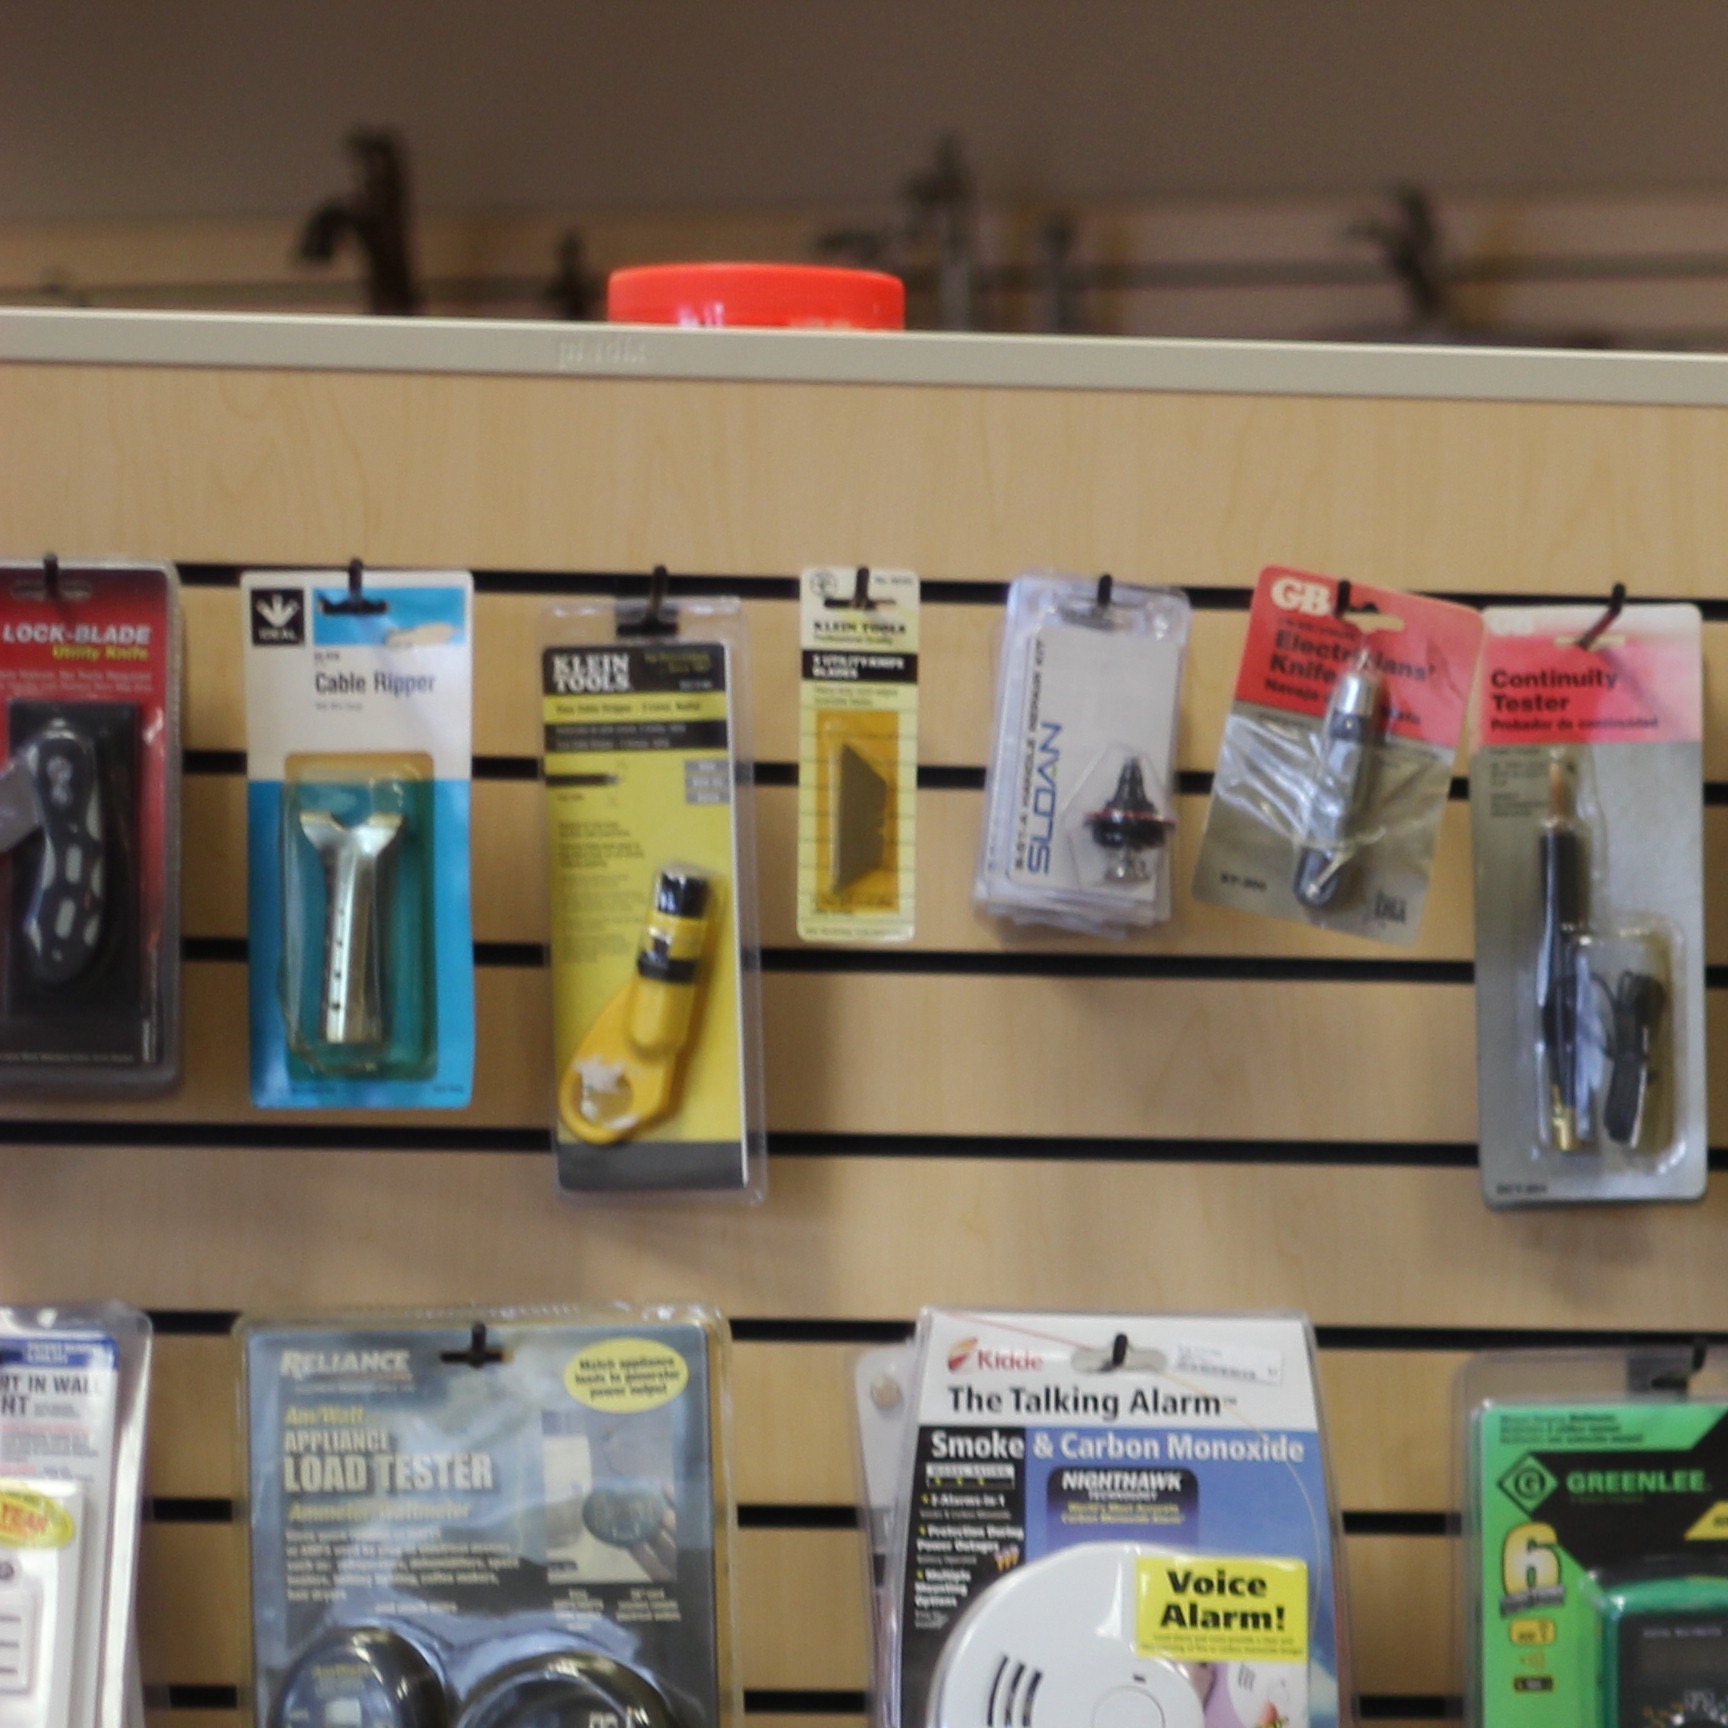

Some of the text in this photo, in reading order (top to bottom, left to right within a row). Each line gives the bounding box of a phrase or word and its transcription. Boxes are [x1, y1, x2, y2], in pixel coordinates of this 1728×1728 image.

[1271, 576, 1333, 616] GB
[2, 623, 151, 645] LOCK-BLADE
[553, 654, 630, 674] KLEIN
[315, 671, 435, 697] Cable Ripper
[554, 674, 631, 692] TOOLS
[1490, 667, 1619, 690] Continuity
[1490, 693, 1570, 712] Tester
[1028, 721, 1063, 875] SLOAN
[280, 1350, 411, 1380] RELIANCE
[976, 1348, 1044, 1372] Kidde
[948, 1386, 1002, 1413] The
[1010, 1386, 1119, 1420] Talking
[931, 1431, 1305, 1463] Smoke & Carbon Monoxide
[283, 1451, 494, 1493] LOAD TESTER
[1062, 1470, 1182, 1491] NIGHTHAWK
[1566, 1470, 1710, 1494] GREENLEE
[1166, 1569, 1267, 1597] Voice
[1160, 1602, 1286, 1631] Alarm!
